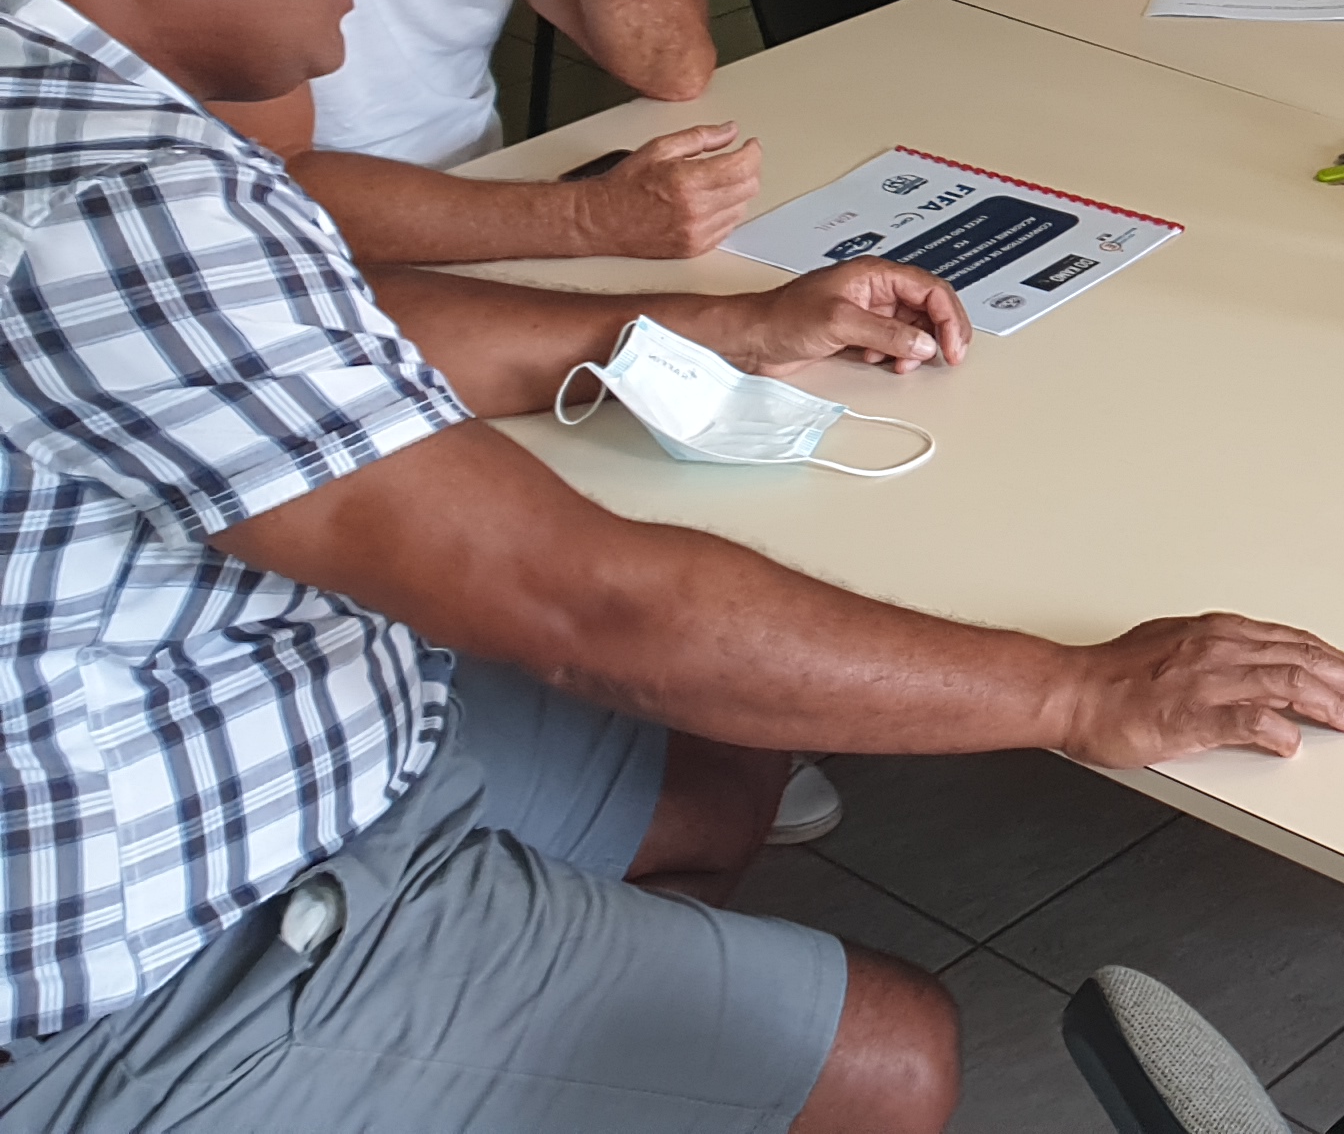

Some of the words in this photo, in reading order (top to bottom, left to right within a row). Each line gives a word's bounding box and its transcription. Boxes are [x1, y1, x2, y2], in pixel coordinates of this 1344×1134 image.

[918, 184, 976, 213] FIFA
[950, 226, 965, 238] DO
[996, 216, 1036, 244] ACADEMIE
[1001, 221, 1053, 252] CONVENTION
[925, 233, 950, 251] KAMO
[987, 246, 1002, 259] DE
[1049, 264, 1077, 282] KAMO
[1074, 257, 1094, 272] DO
